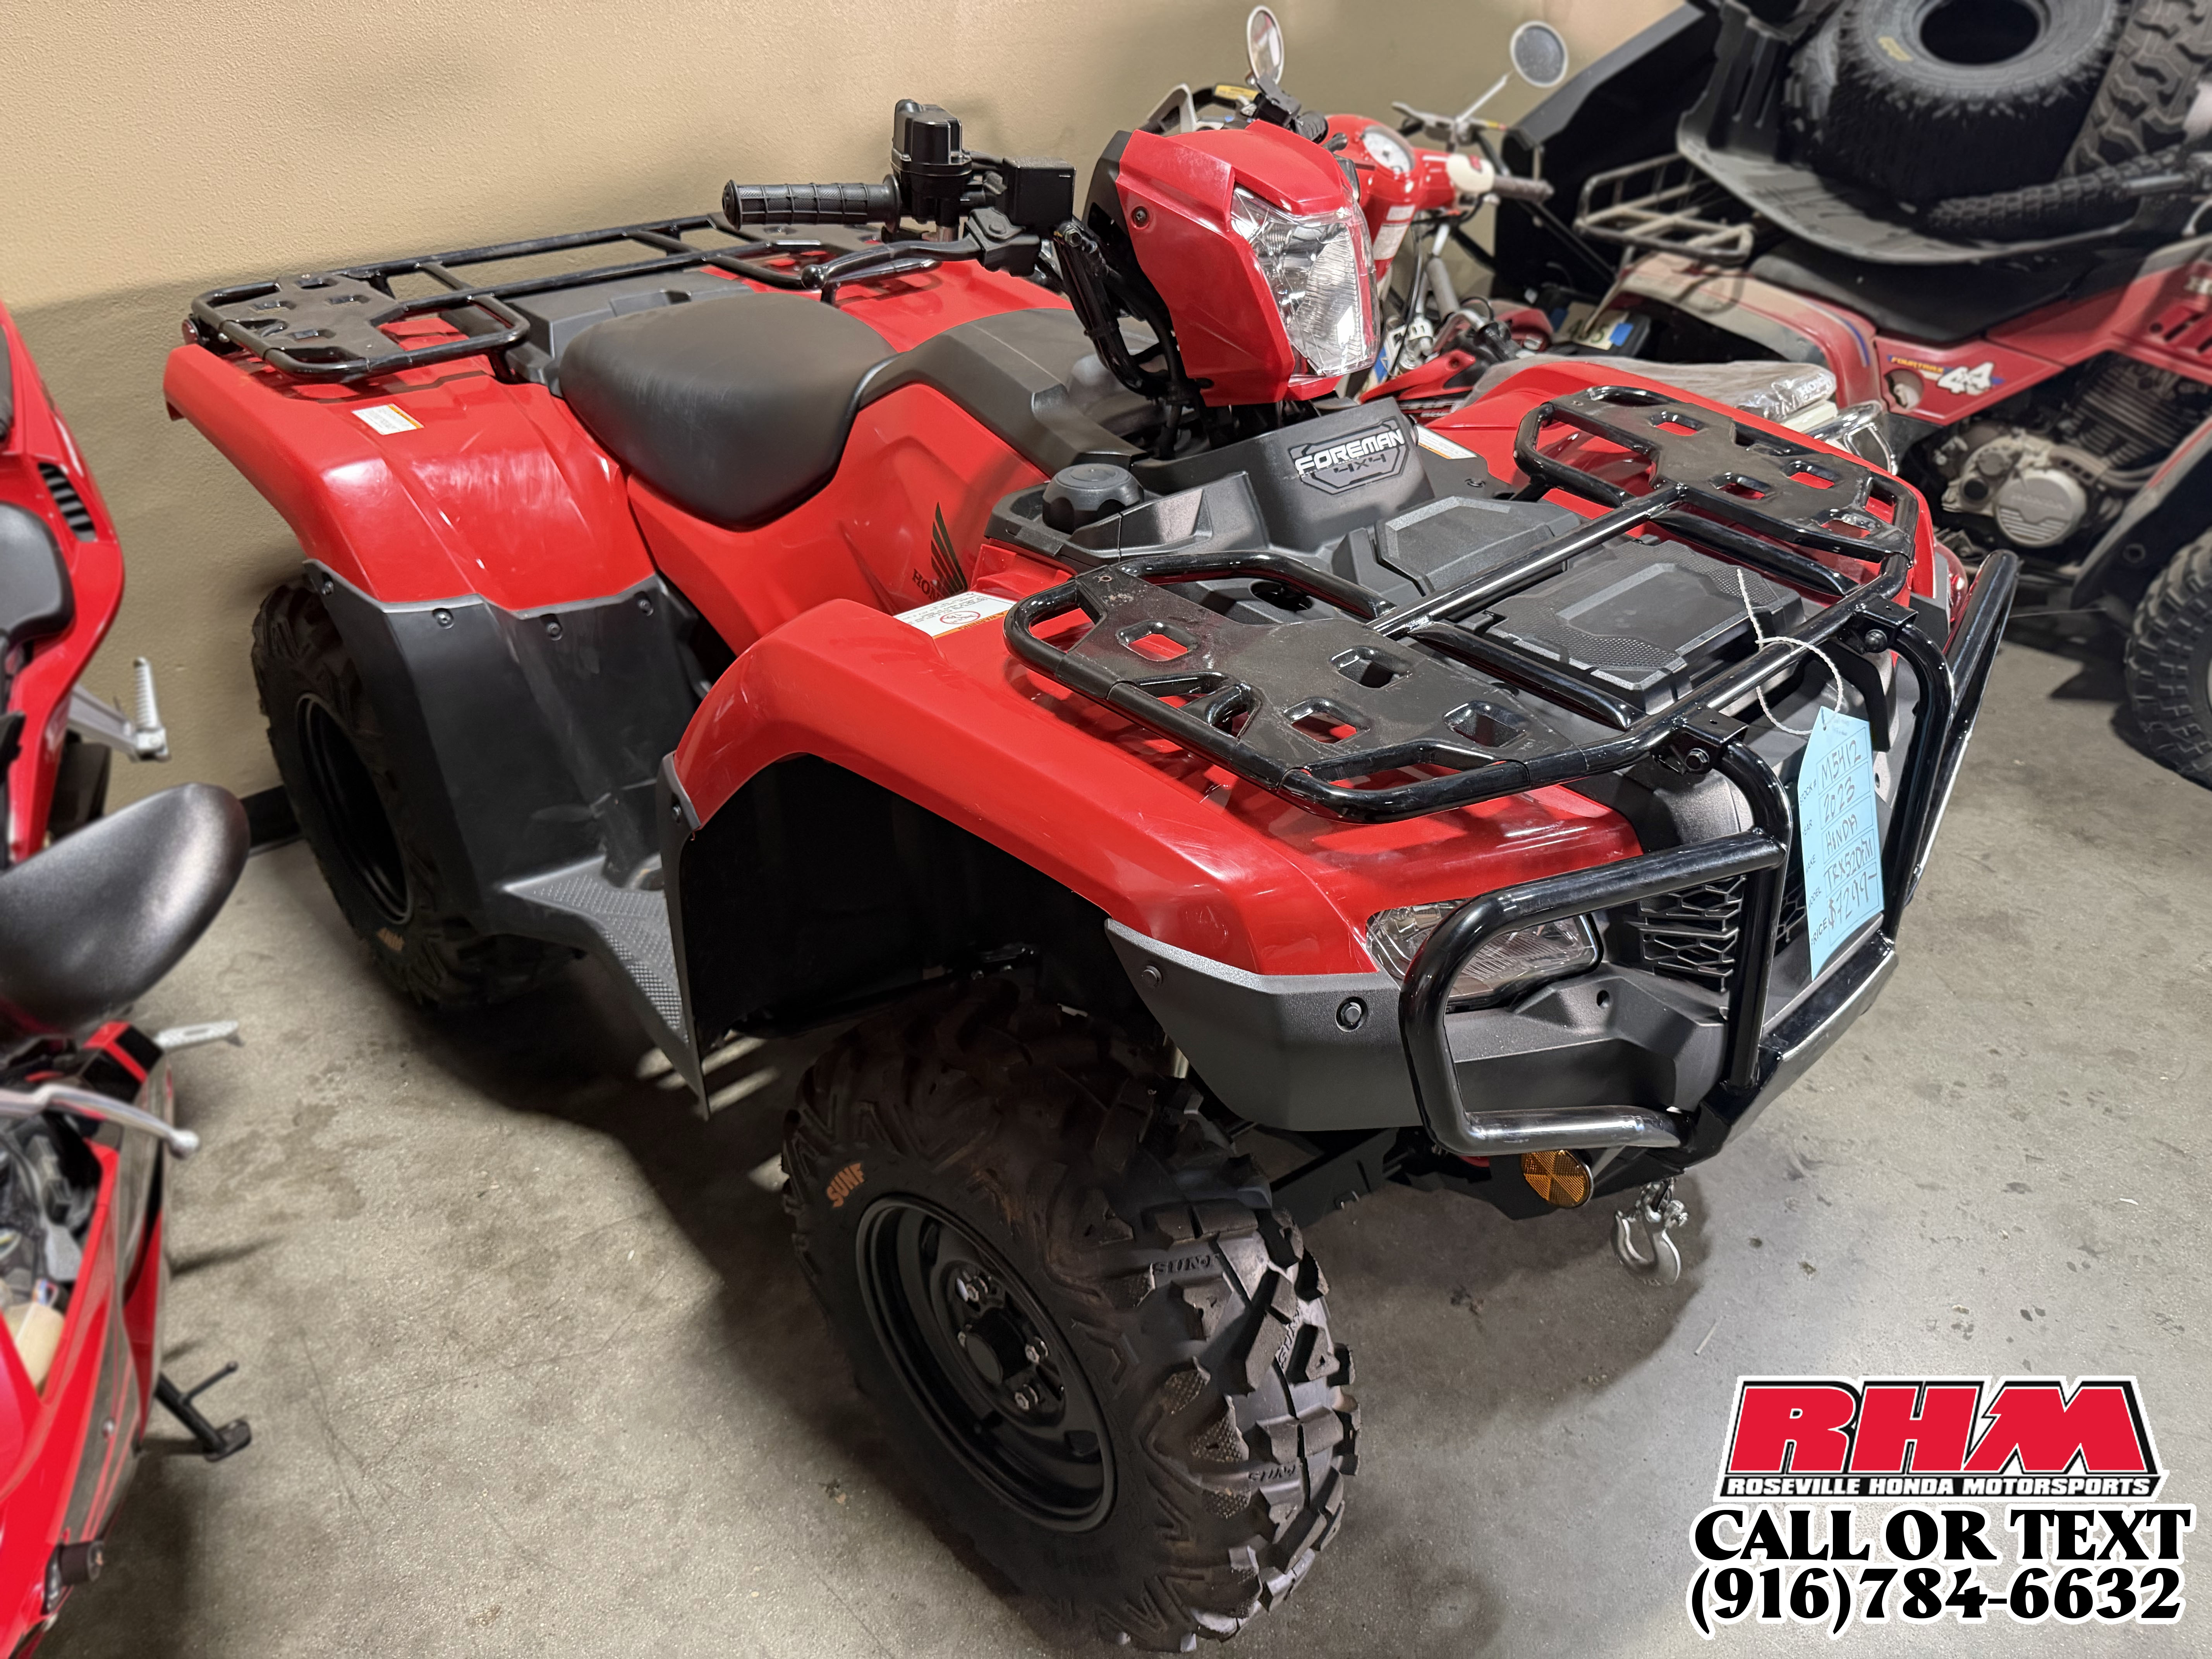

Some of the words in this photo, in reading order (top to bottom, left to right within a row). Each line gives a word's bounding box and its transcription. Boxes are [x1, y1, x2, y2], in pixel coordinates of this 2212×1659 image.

[1295, 428, 1405, 476] FOREMAN
[1822, 739, 1861, 789] M5412
[1824, 776, 1855, 824] 2023
[1826, 814, 1858, 856] HONDA
[1810, 917, 1828, 946] PRICE
[826, 1162, 865, 1209] SUNF
